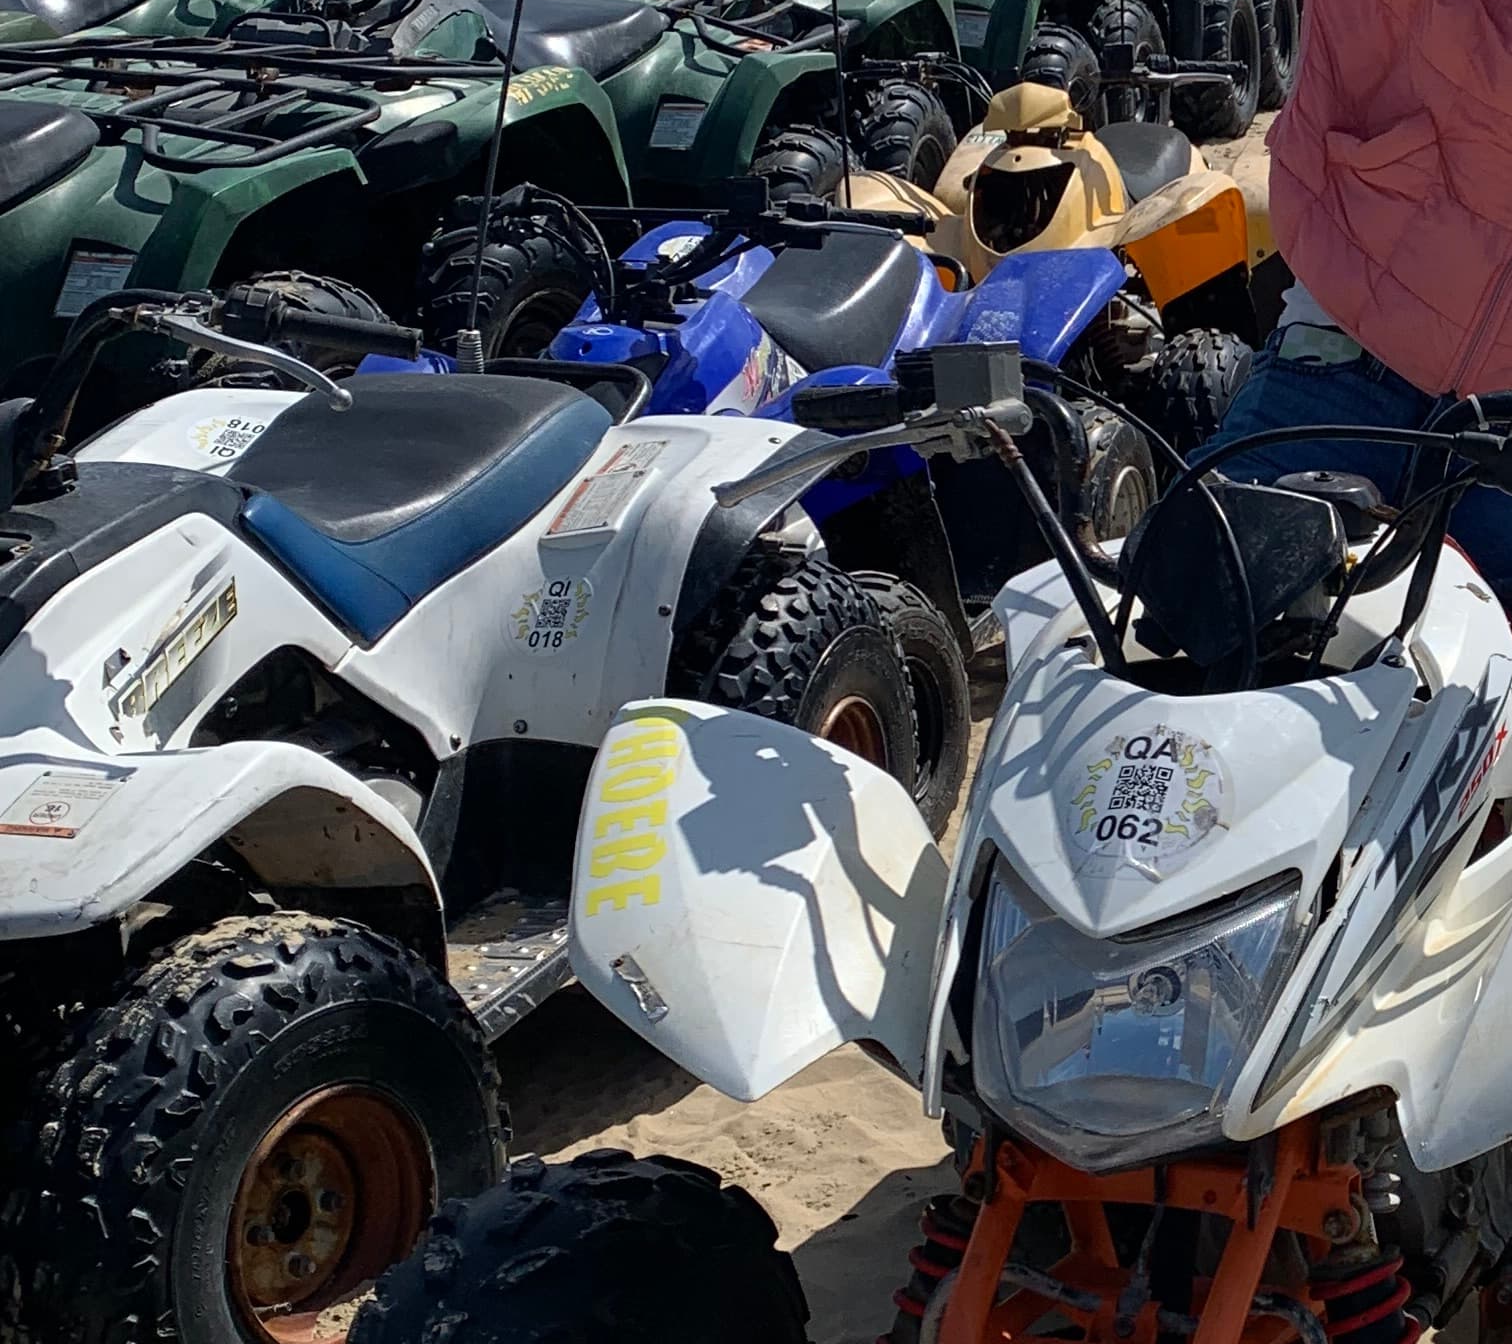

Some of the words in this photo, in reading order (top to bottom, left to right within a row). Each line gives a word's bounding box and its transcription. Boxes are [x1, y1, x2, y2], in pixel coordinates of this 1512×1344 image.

[227, 418, 265, 434] 018
[548, 580, 572, 597] QI
[528, 631, 563, 648] 018
[1124, 736, 1178, 763] QA
[1096, 814, 1164, 847] 062
